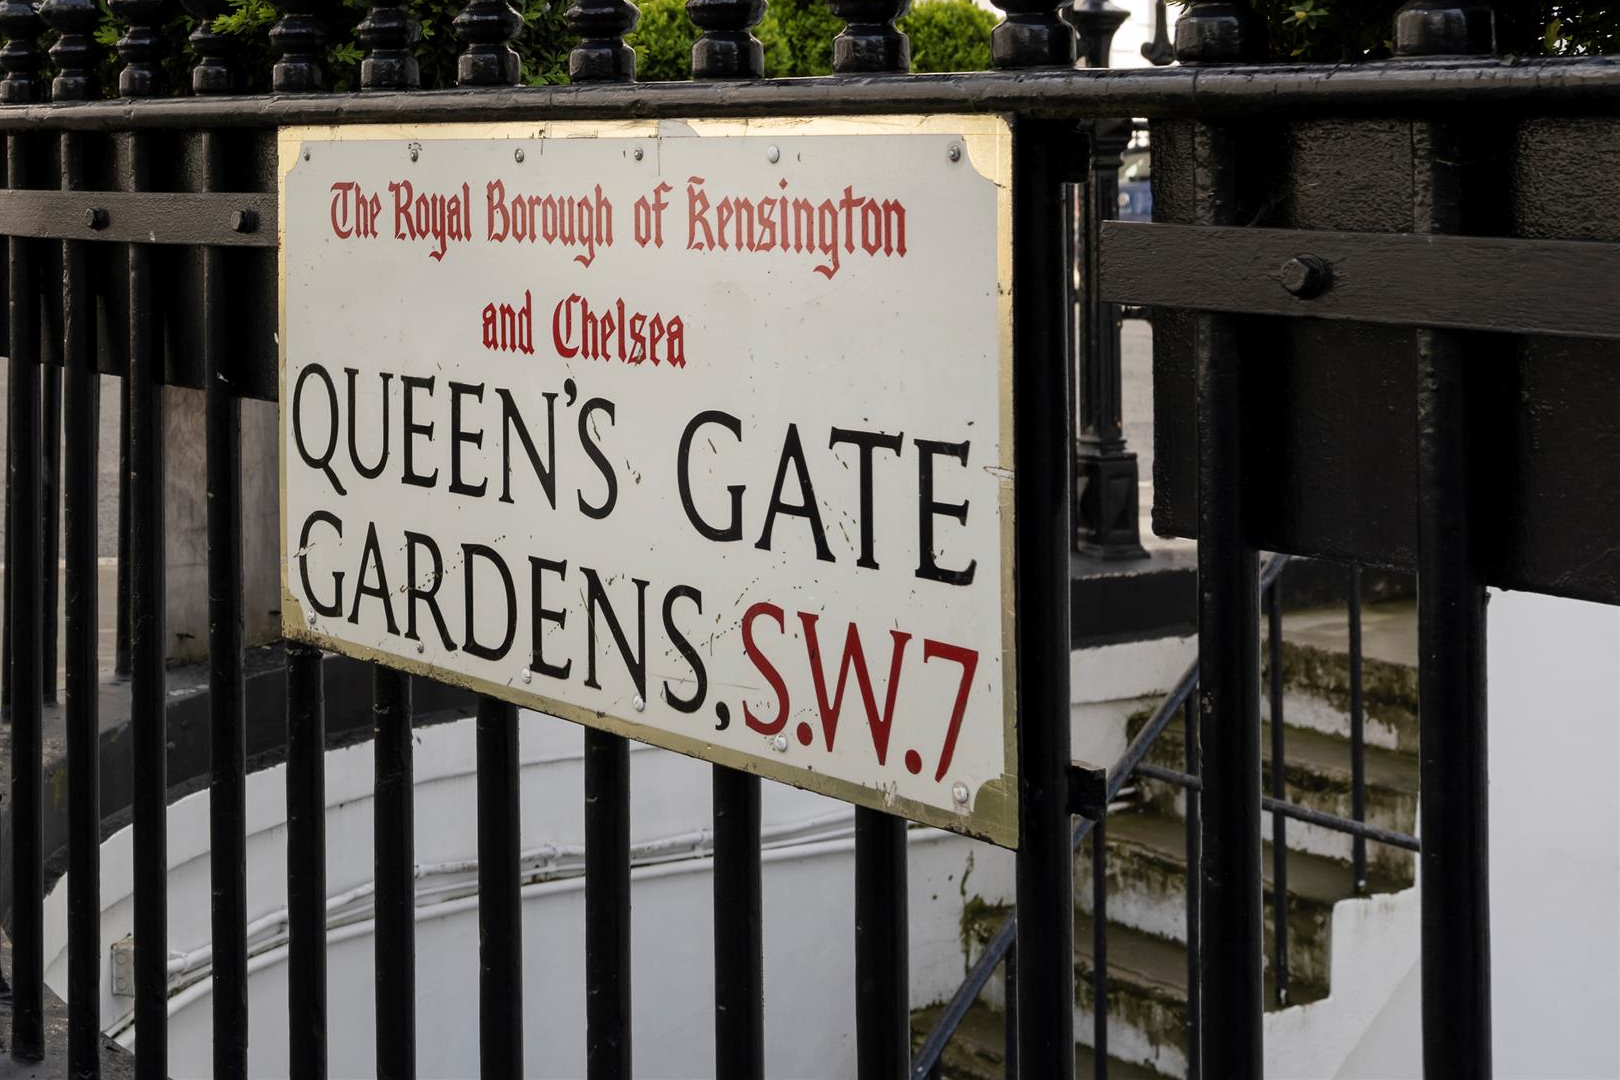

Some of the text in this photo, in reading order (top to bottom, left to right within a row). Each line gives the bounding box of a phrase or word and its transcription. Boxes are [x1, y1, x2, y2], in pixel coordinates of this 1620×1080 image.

[331, 176, 907, 280] The Royal Borough of Kensington
[481, 290, 686, 369] and Chelsea
[293, 363, 978, 587] QUEEN'S GATE
[298, 510, 980, 783] GARDENS, S.W.7
